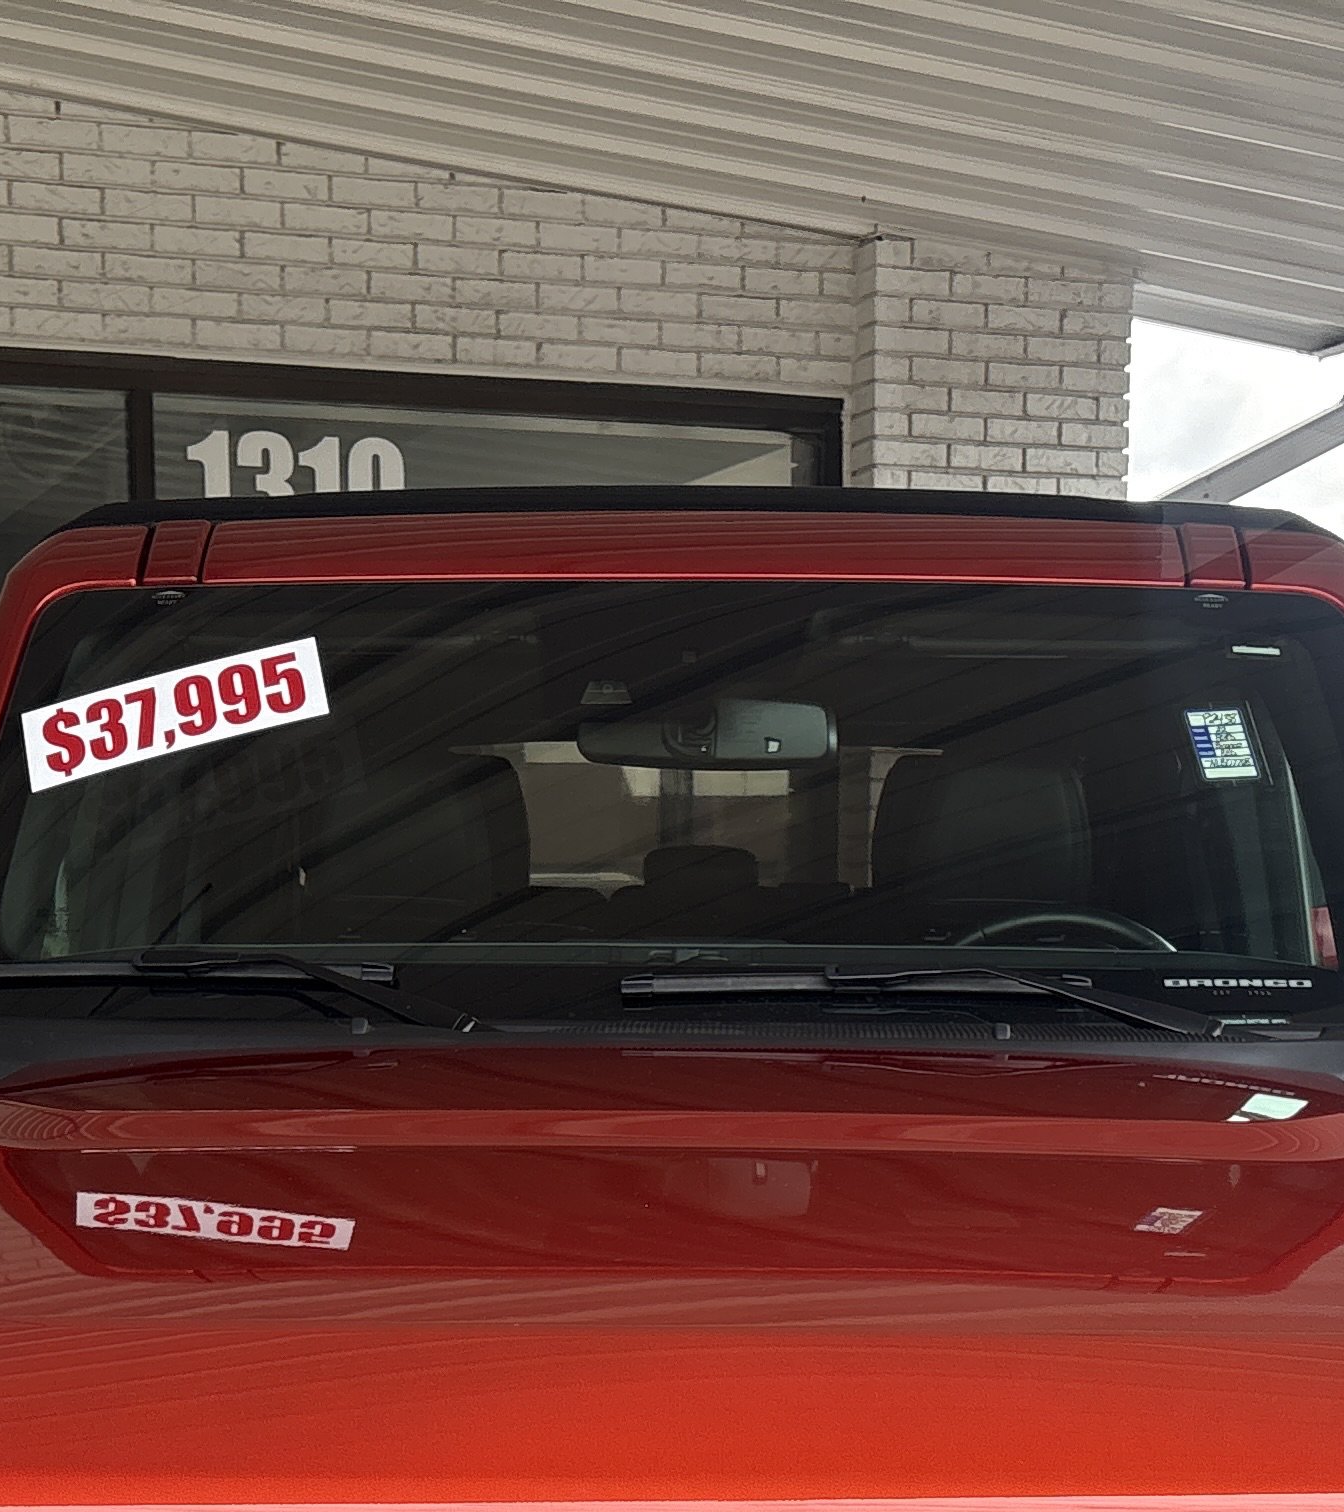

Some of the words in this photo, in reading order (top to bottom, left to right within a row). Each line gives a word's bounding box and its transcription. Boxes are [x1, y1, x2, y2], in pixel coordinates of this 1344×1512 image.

[186, 429, 406, 498] 1310
[42, 651, 307, 777] $37,995
[1163, 978, 1313, 988] BRONCO
